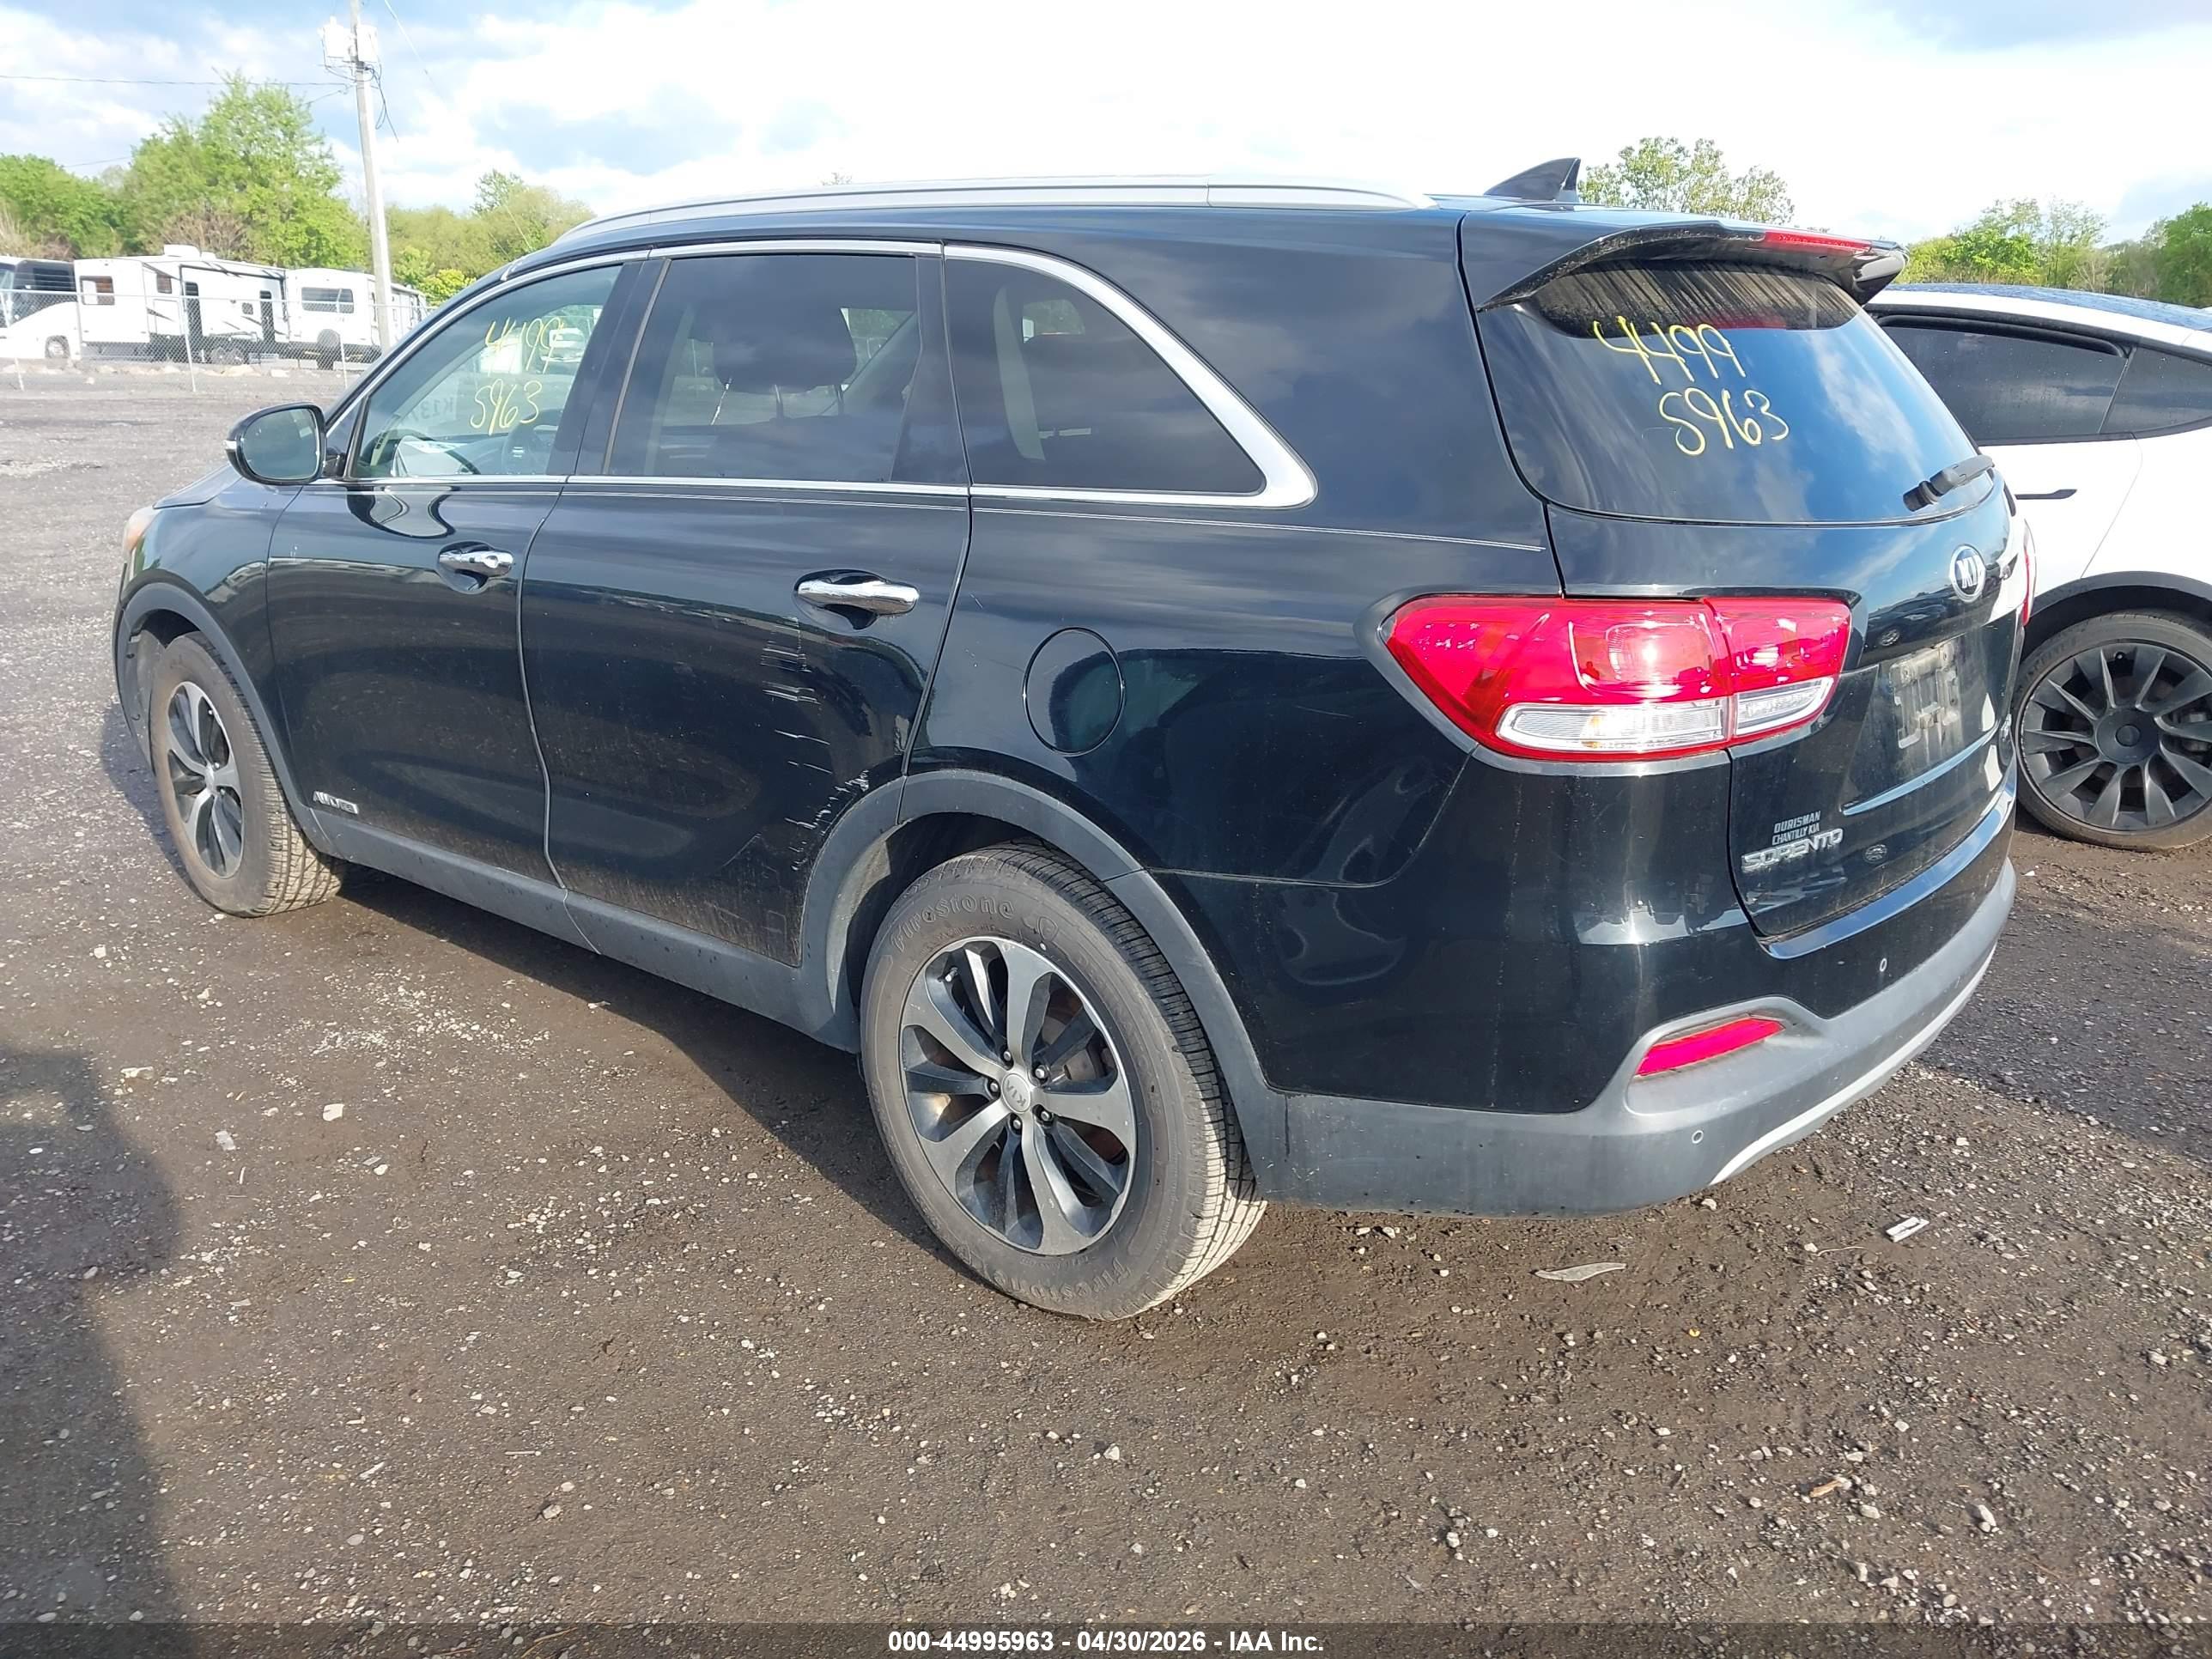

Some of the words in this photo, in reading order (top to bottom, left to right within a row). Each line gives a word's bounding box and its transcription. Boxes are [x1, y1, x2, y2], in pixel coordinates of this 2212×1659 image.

[484, 316, 565, 376] 4499
[1593, 314, 1747, 385] 4499
[470, 379, 543, 435] 5963
[1658, 386, 1790, 455] 5963
[1772, 825, 1808, 846] CHANTILLY
[1808, 823, 1820, 836] KIA
[1773, 810, 1821, 833] OURISMAN
[1741, 828, 1844, 872] SORENTO
[890, 892, 1015, 952] Firestone
[1006, 1079, 1027, 1107] KIA
